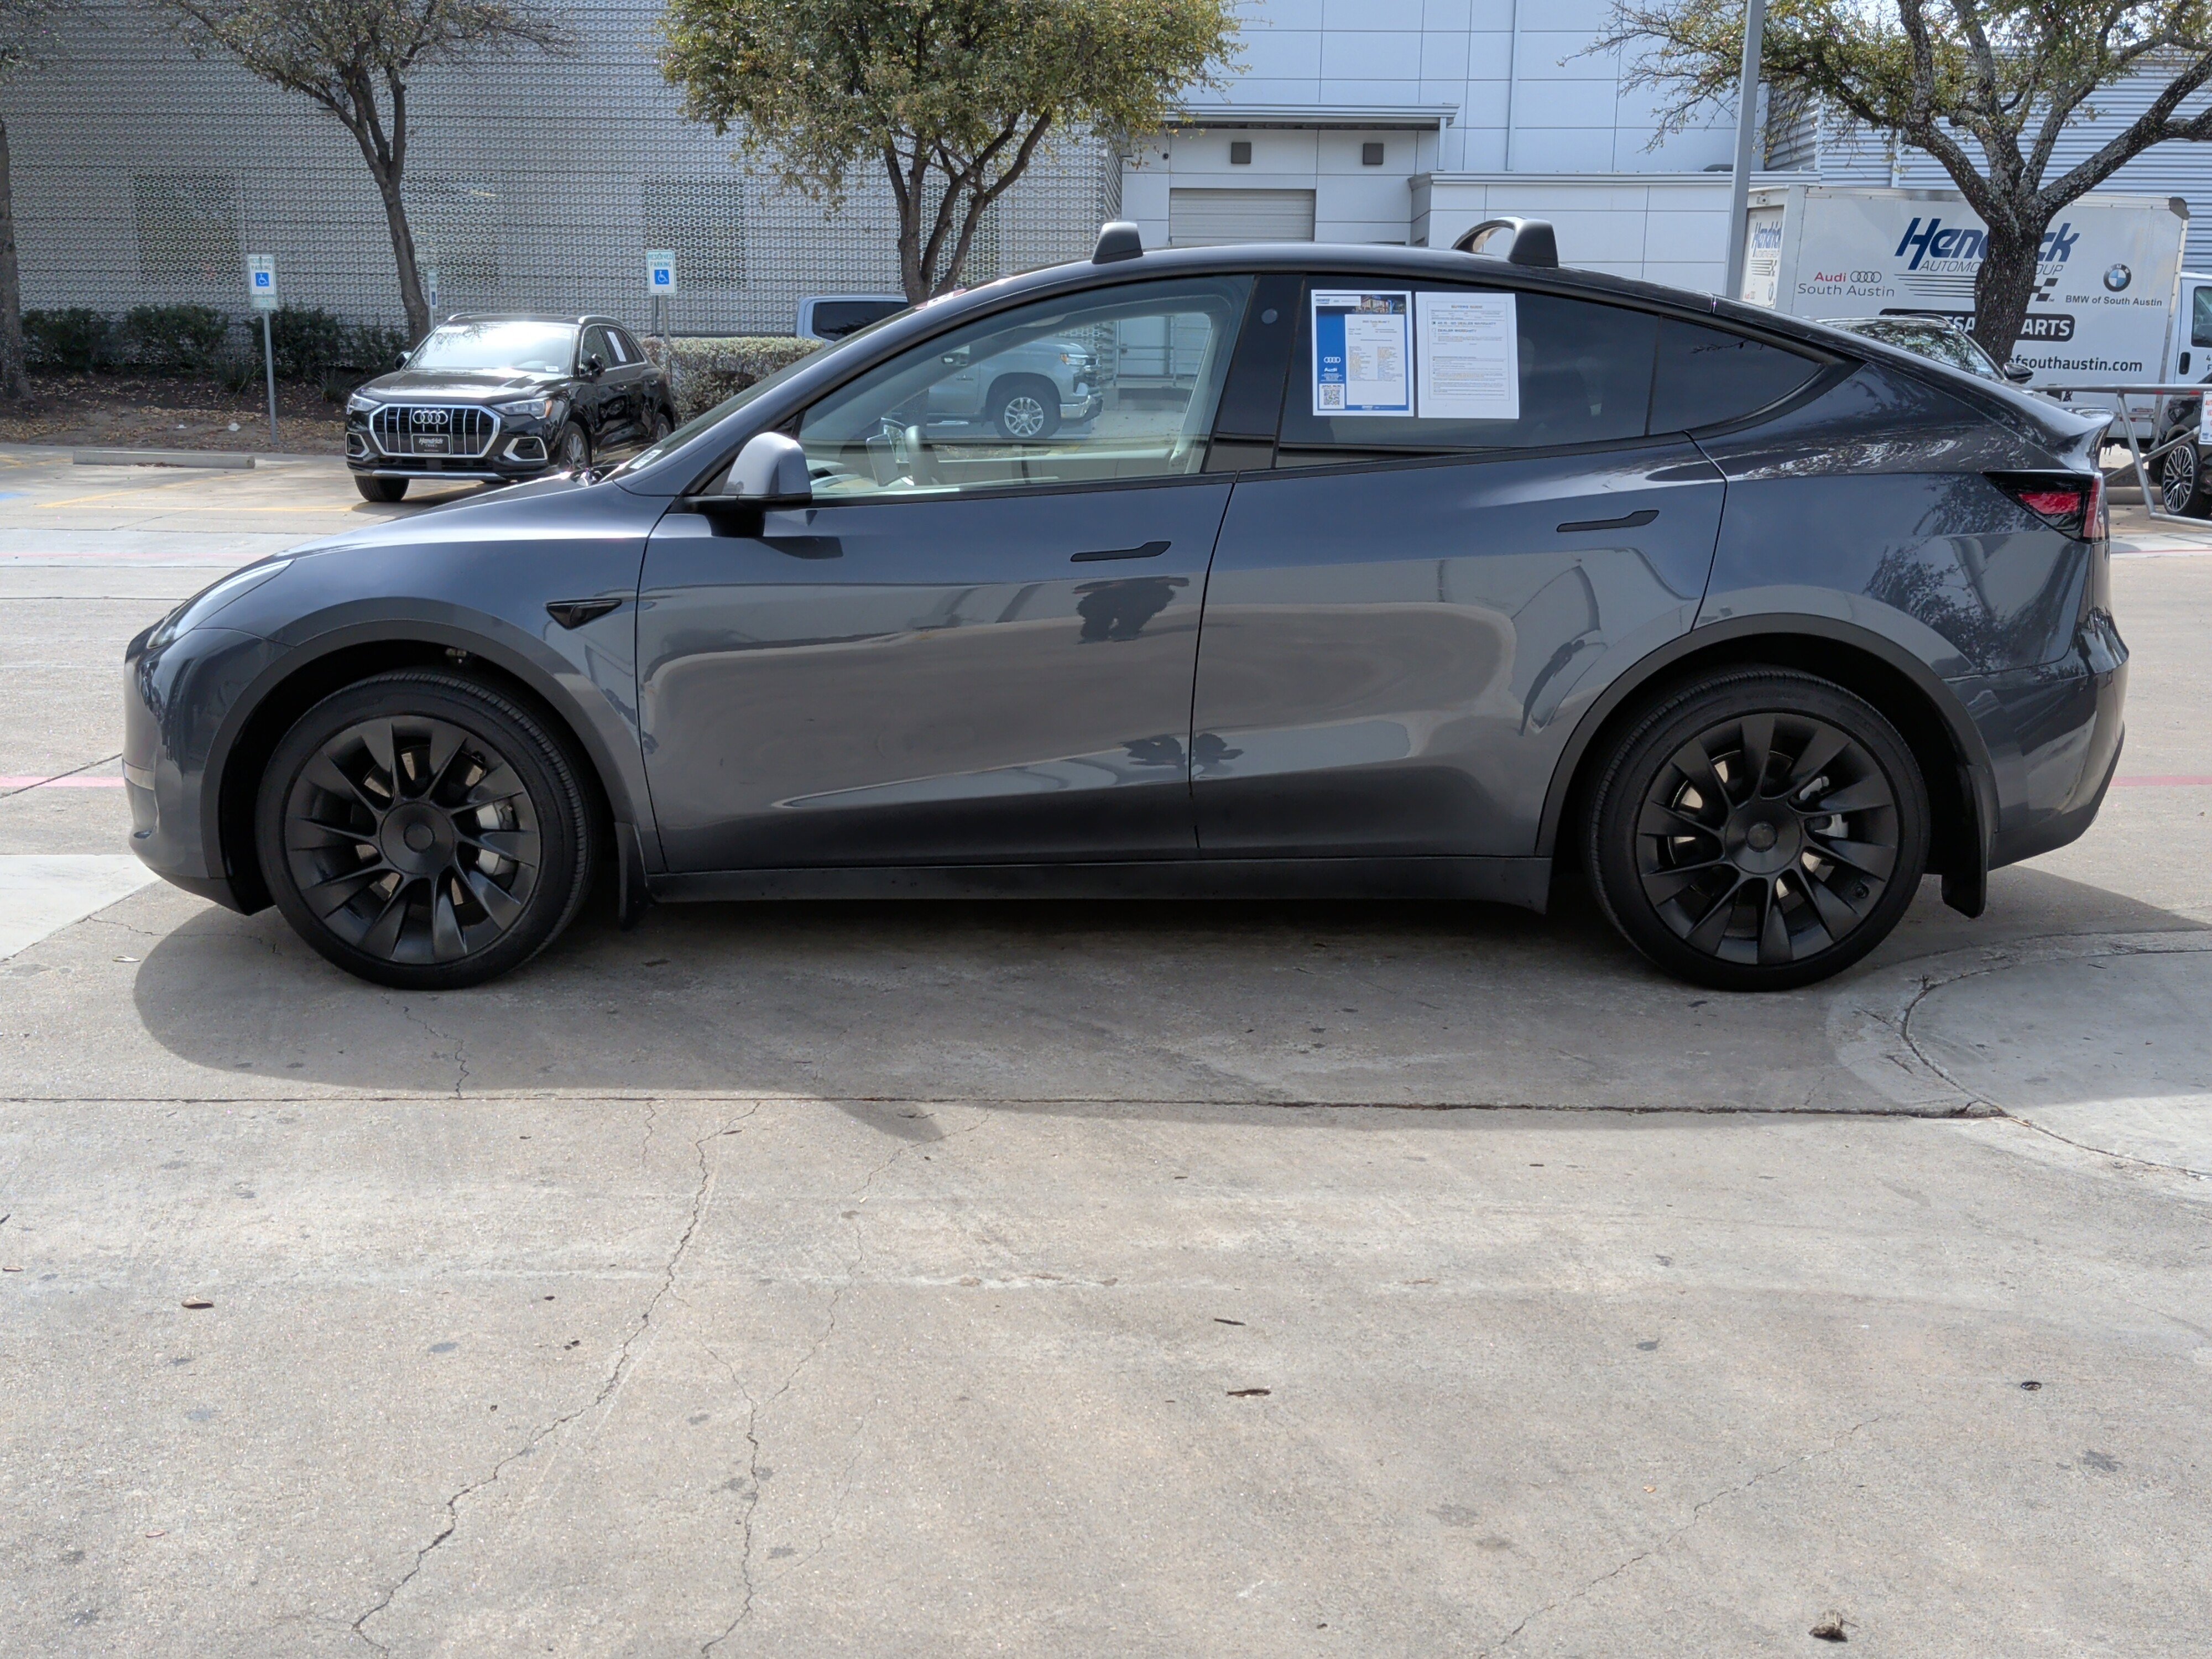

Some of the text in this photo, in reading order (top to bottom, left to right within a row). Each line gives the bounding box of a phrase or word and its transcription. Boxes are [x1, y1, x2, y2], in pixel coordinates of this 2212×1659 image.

[1894, 217, 2080, 270] Henck
[1919, 260, 1982, 273] AUTOMO
[1814, 271, 1847, 283] Audi
[1797, 283, 1895, 297] South Austin
[2065, 295, 2162, 306] BMW of South Austin
[2020, 319, 2071, 337] ARTS
